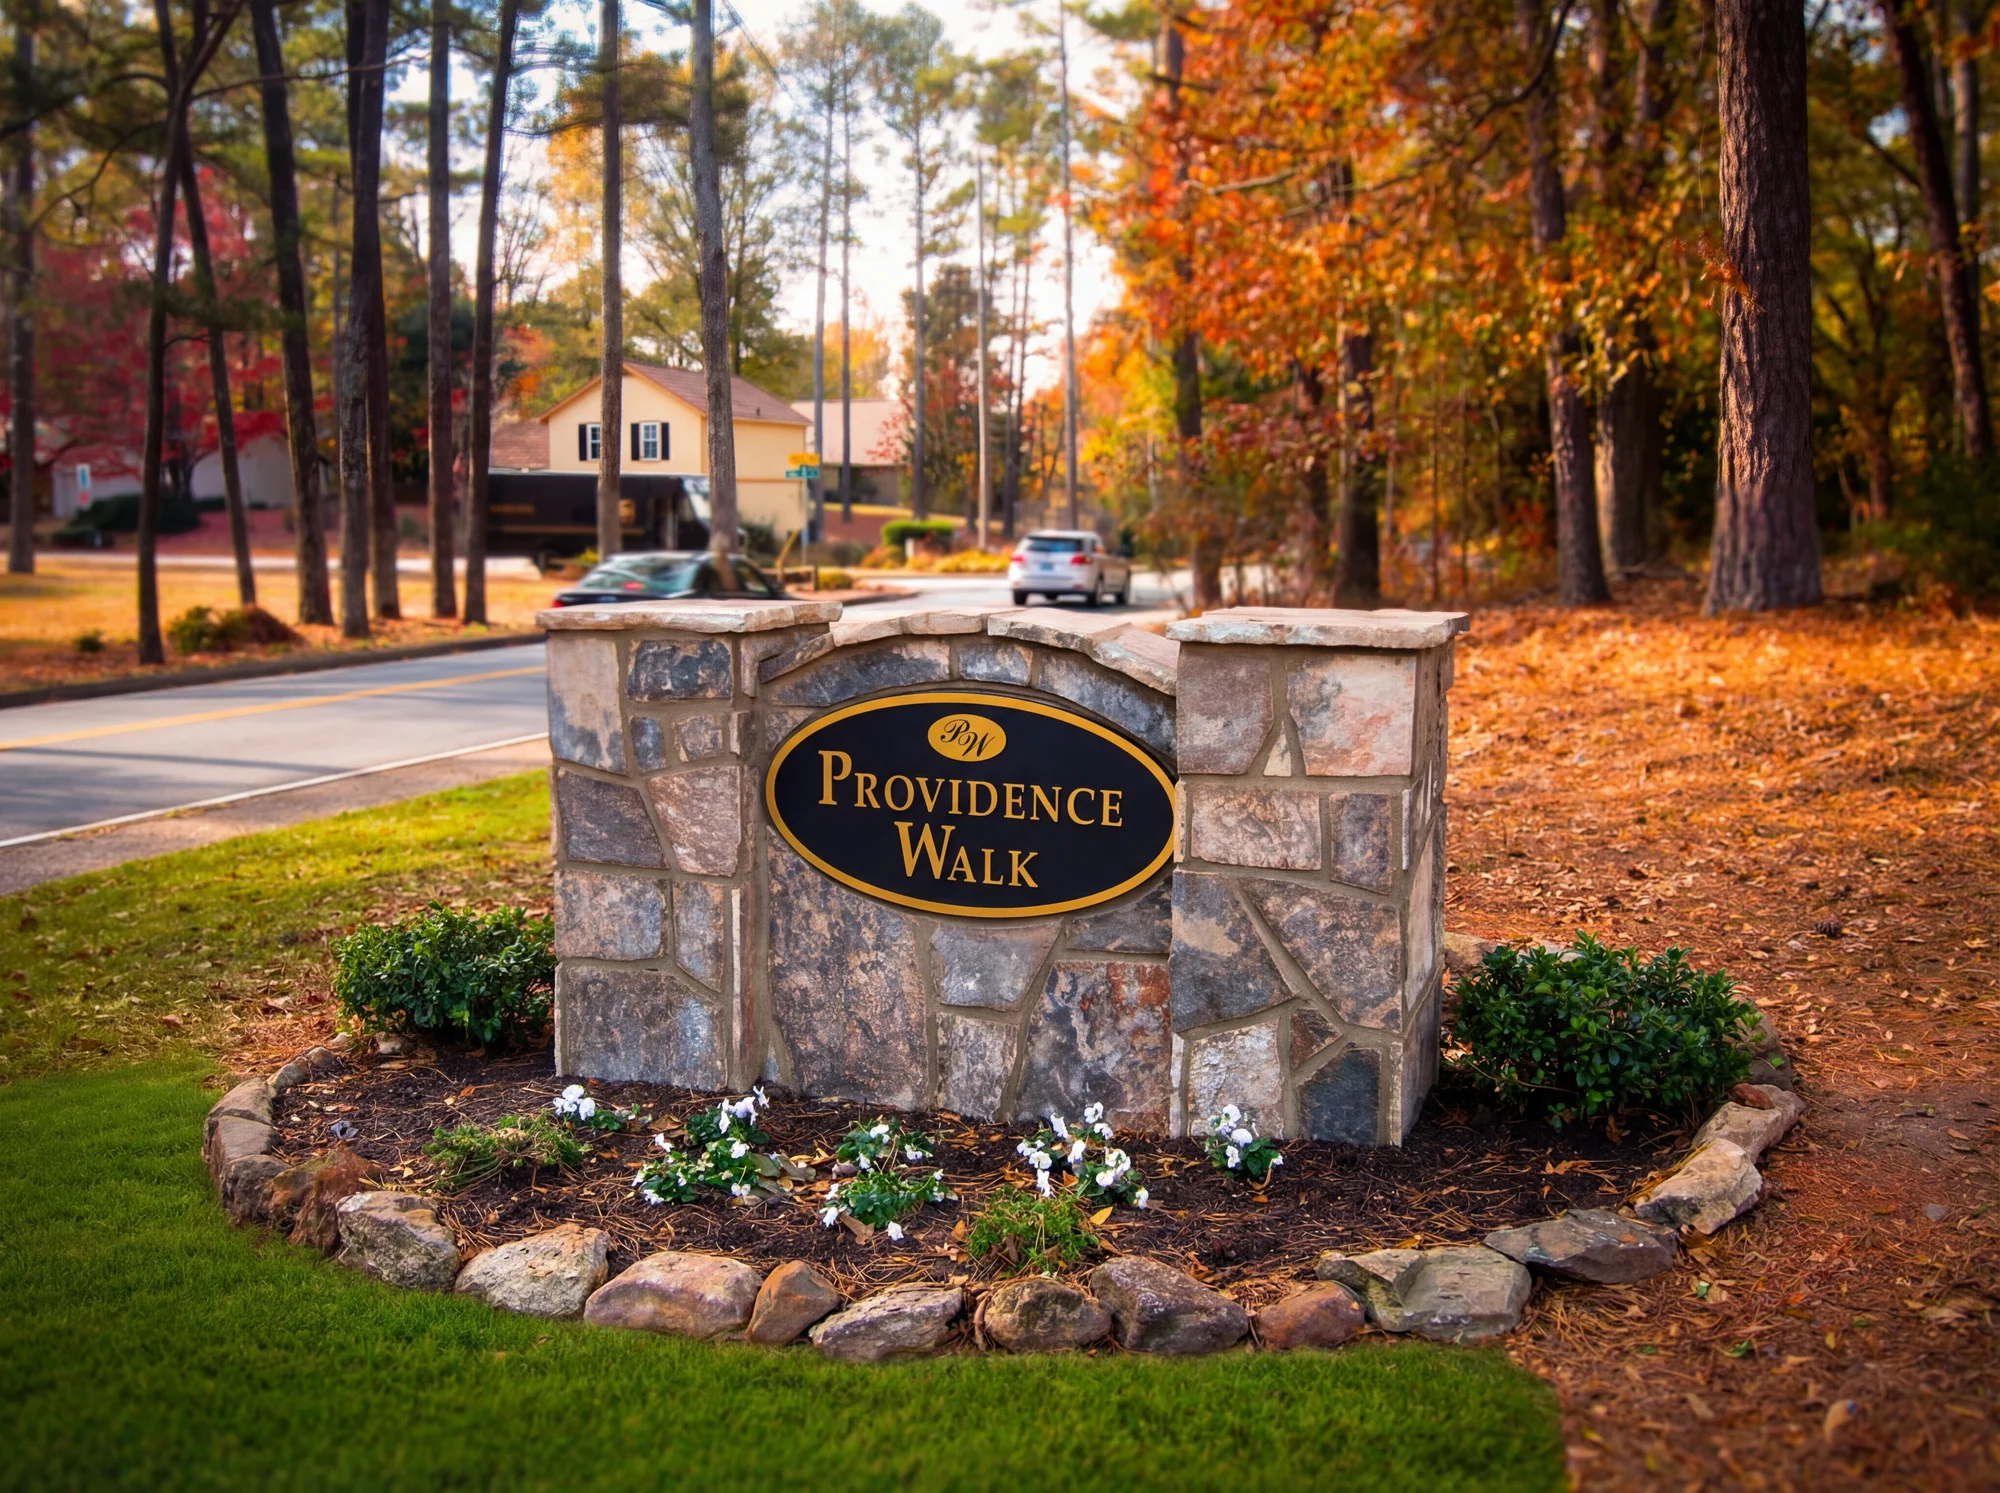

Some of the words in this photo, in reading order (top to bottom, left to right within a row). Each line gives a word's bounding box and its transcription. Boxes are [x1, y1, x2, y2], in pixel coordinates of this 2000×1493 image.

[940, 719, 996, 757] PW
[818, 750, 1123, 827] PROVIDENCE
[894, 821, 1039, 888] WALK
